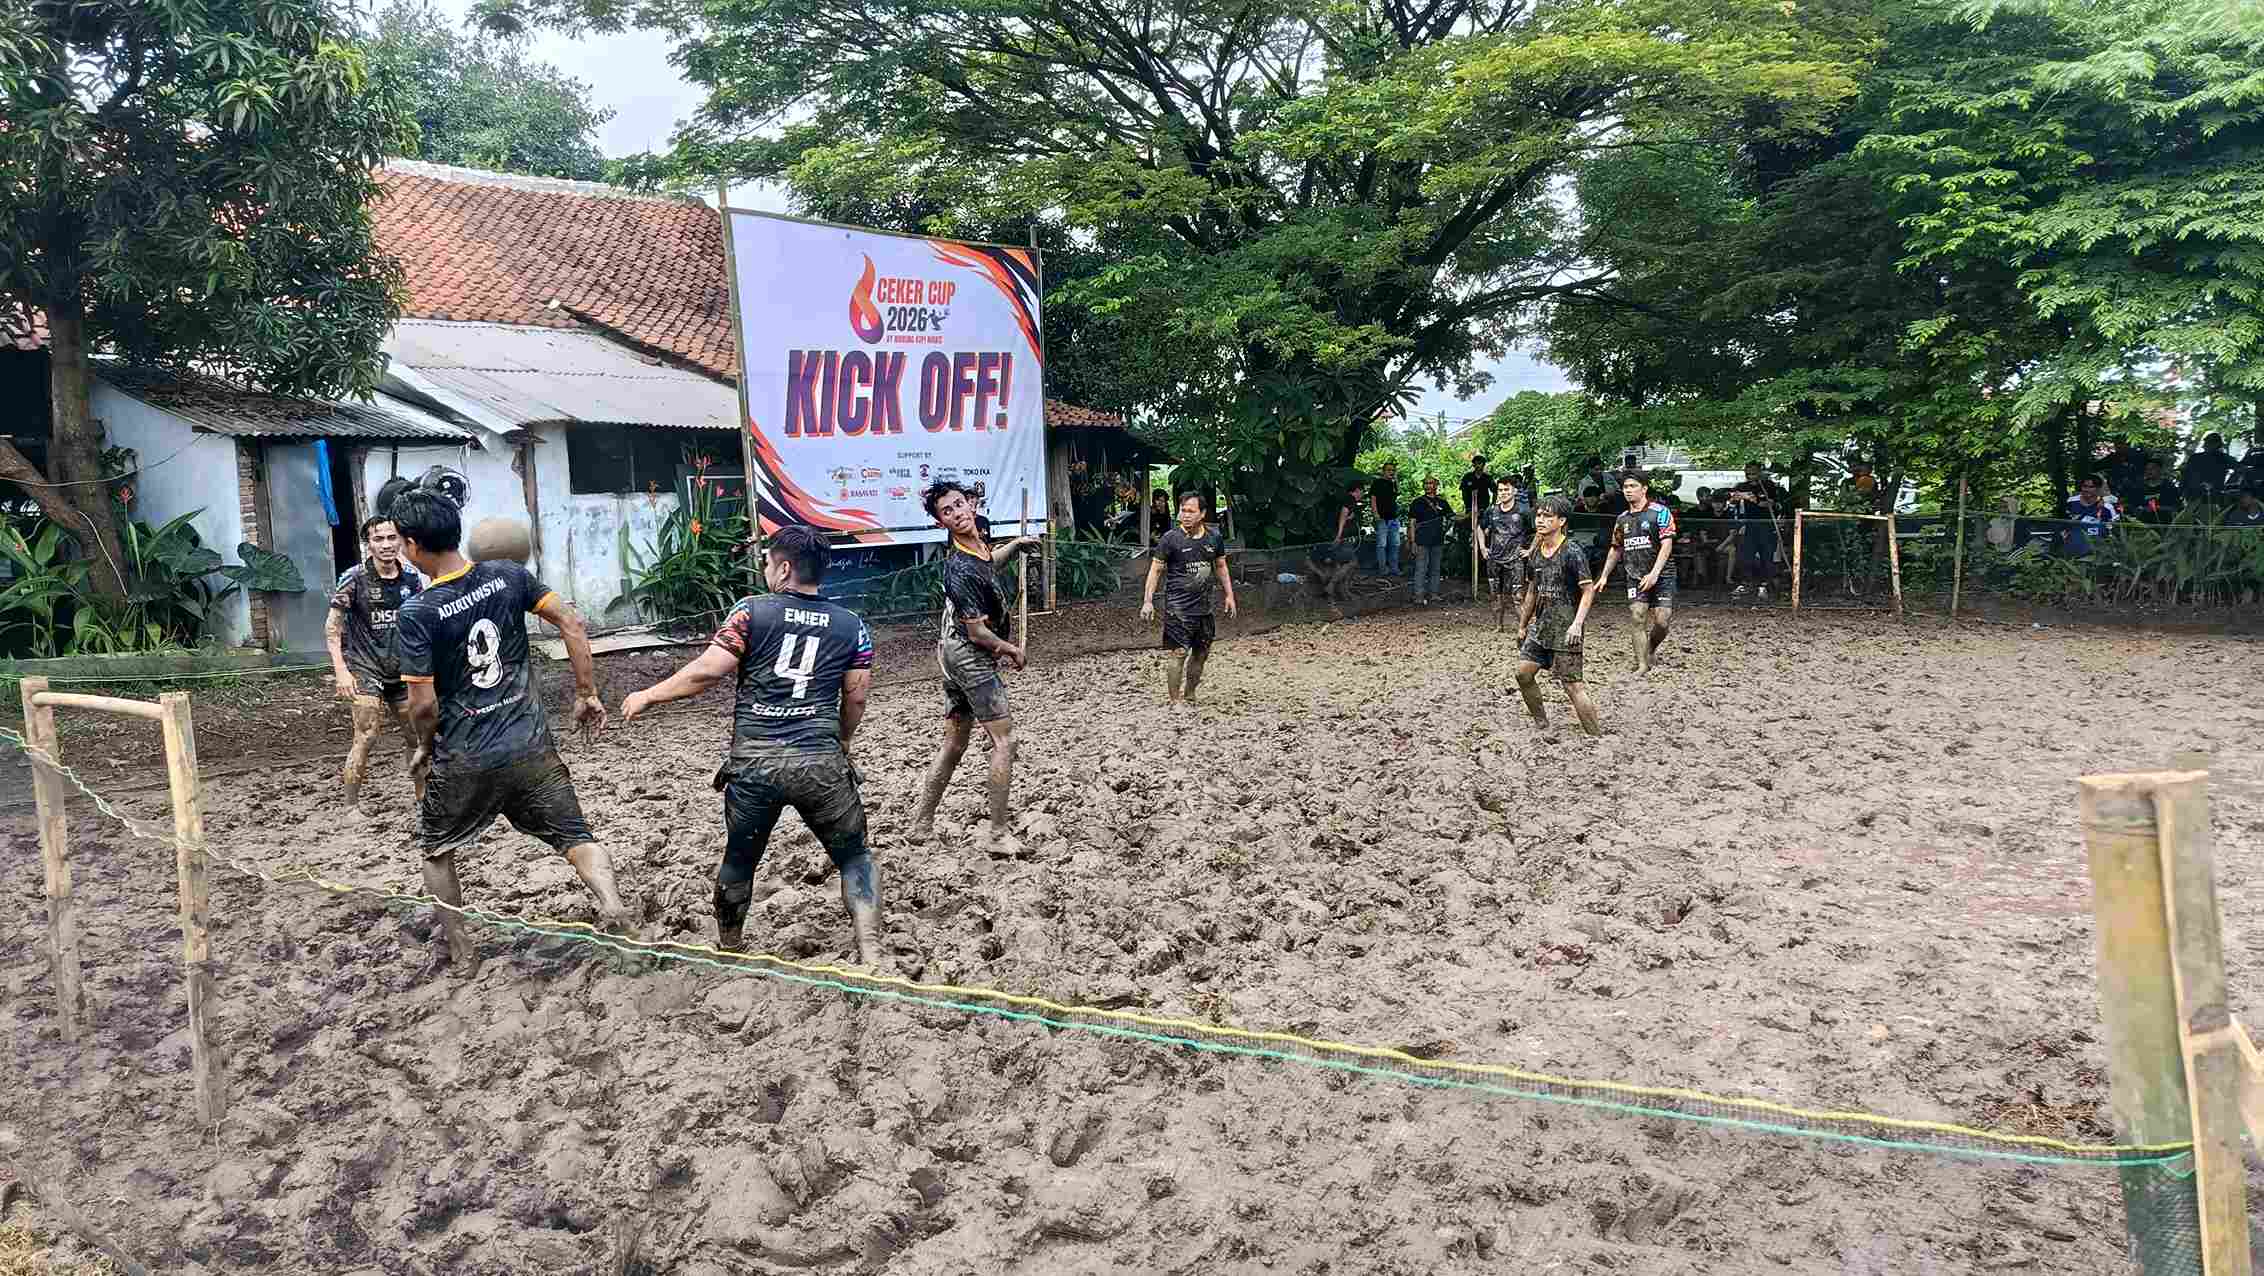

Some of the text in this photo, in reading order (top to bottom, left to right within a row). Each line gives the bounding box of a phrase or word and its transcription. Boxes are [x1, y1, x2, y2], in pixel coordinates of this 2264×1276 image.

[877, 278, 956, 305] CEKER CUP
[887, 306, 928, 331] 2026
[784, 350, 1013, 438] KICK OFF!
[466, 618, 503, 690] 9
[774, 633, 820, 700] 4
